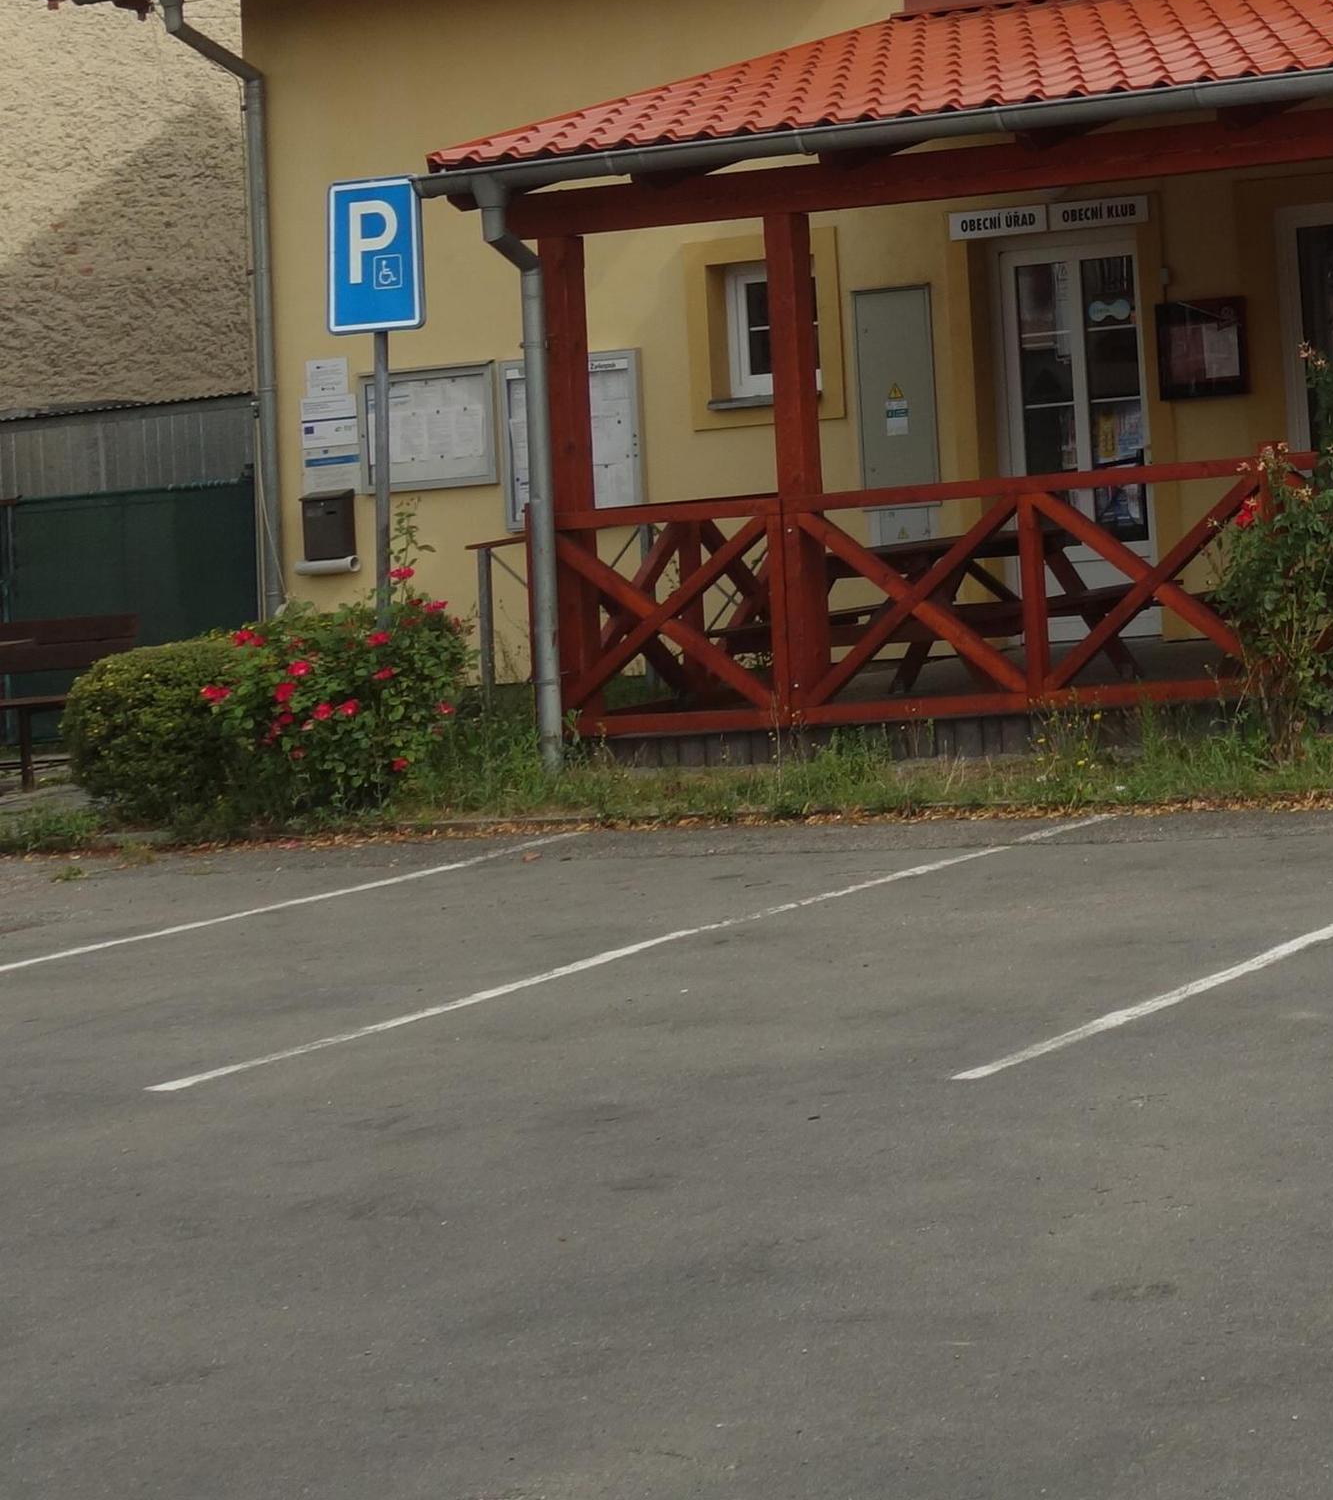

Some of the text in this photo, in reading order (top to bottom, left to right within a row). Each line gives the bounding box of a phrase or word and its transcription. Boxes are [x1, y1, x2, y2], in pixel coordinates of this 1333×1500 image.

[961, 211, 1036, 233] OBECNÍ ÚŘAD
[1062, 202, 1137, 223] OBECNÍ KLUB
[348, 200, 399, 284] P
